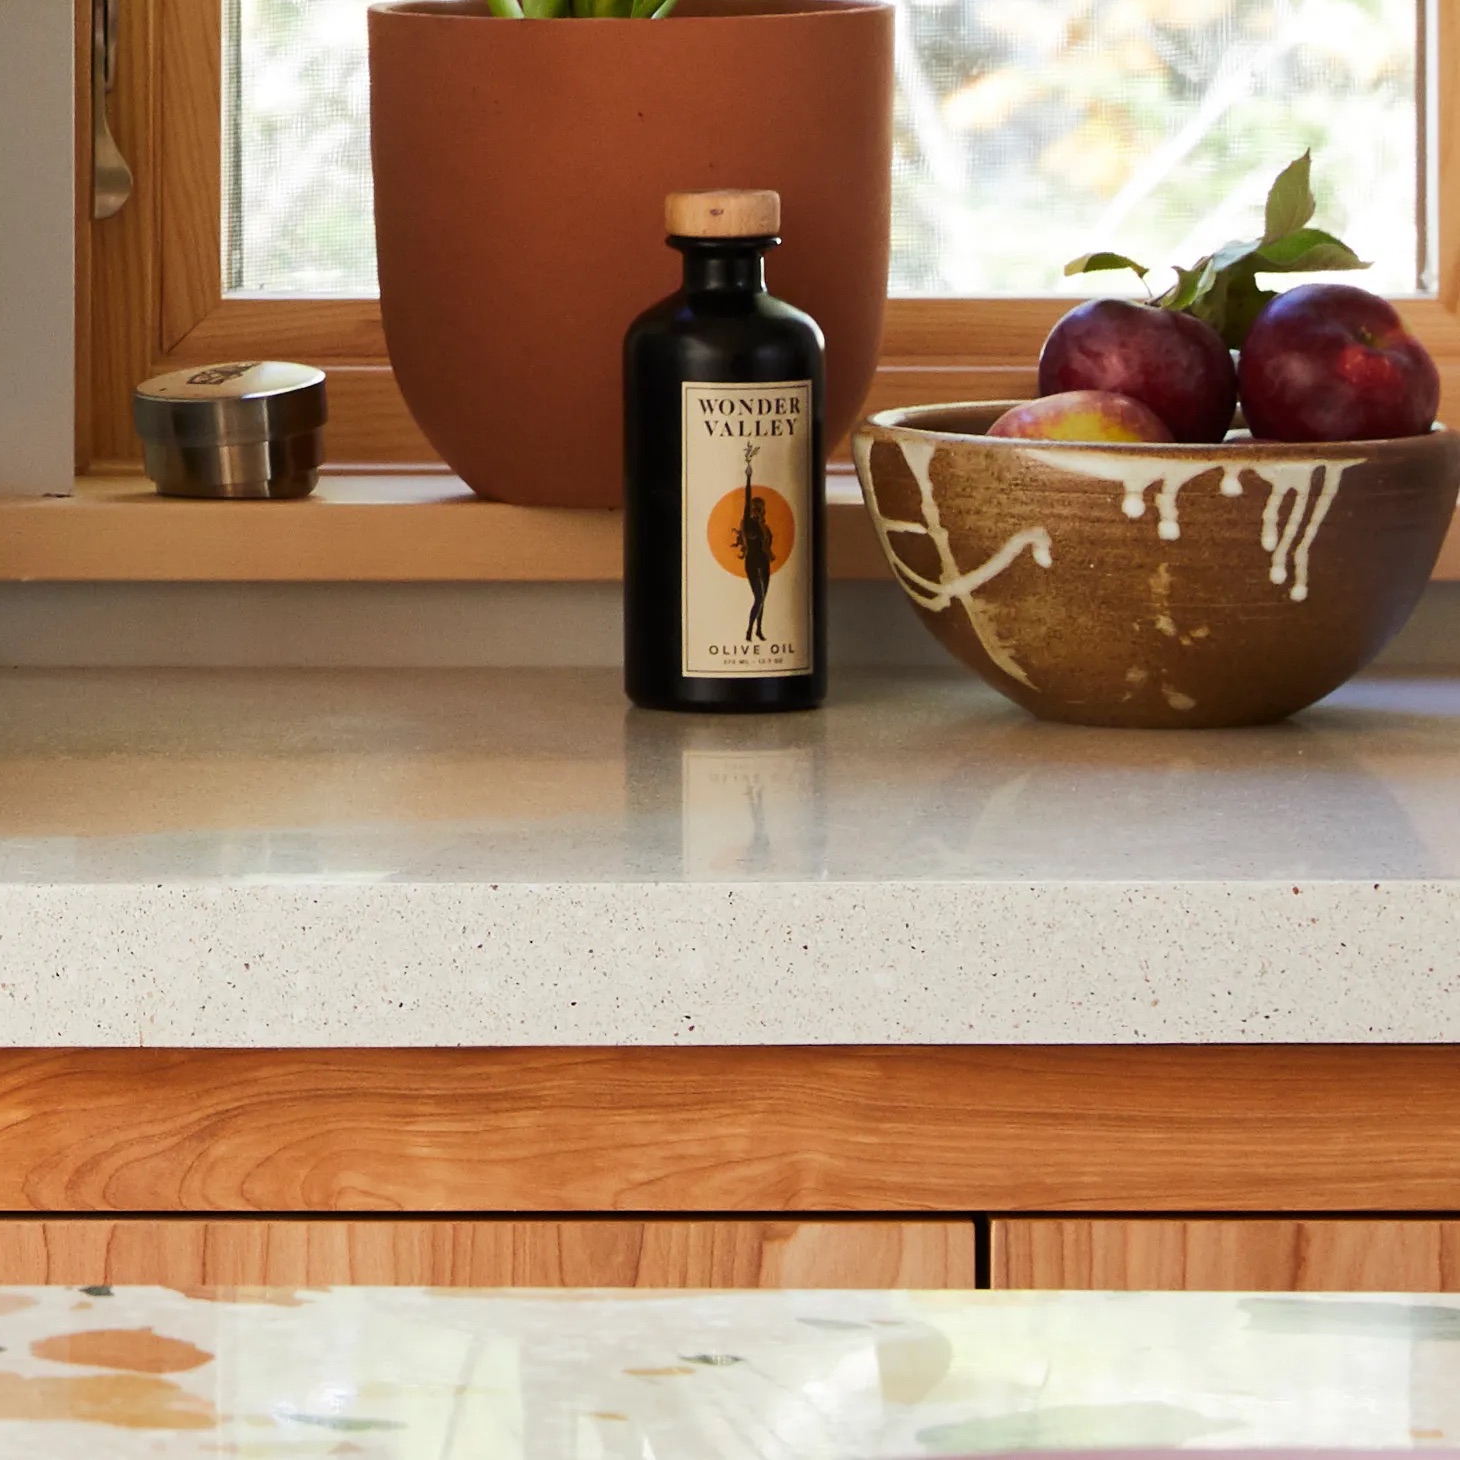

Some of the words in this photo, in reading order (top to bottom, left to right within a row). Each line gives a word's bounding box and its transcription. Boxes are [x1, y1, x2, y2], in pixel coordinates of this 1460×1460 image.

[698, 397, 801, 416] WONDER
[704, 418, 797, 437] VALLEY
[708, 644, 760, 655] OLIVE
[770, 643, 795, 655] OIL
